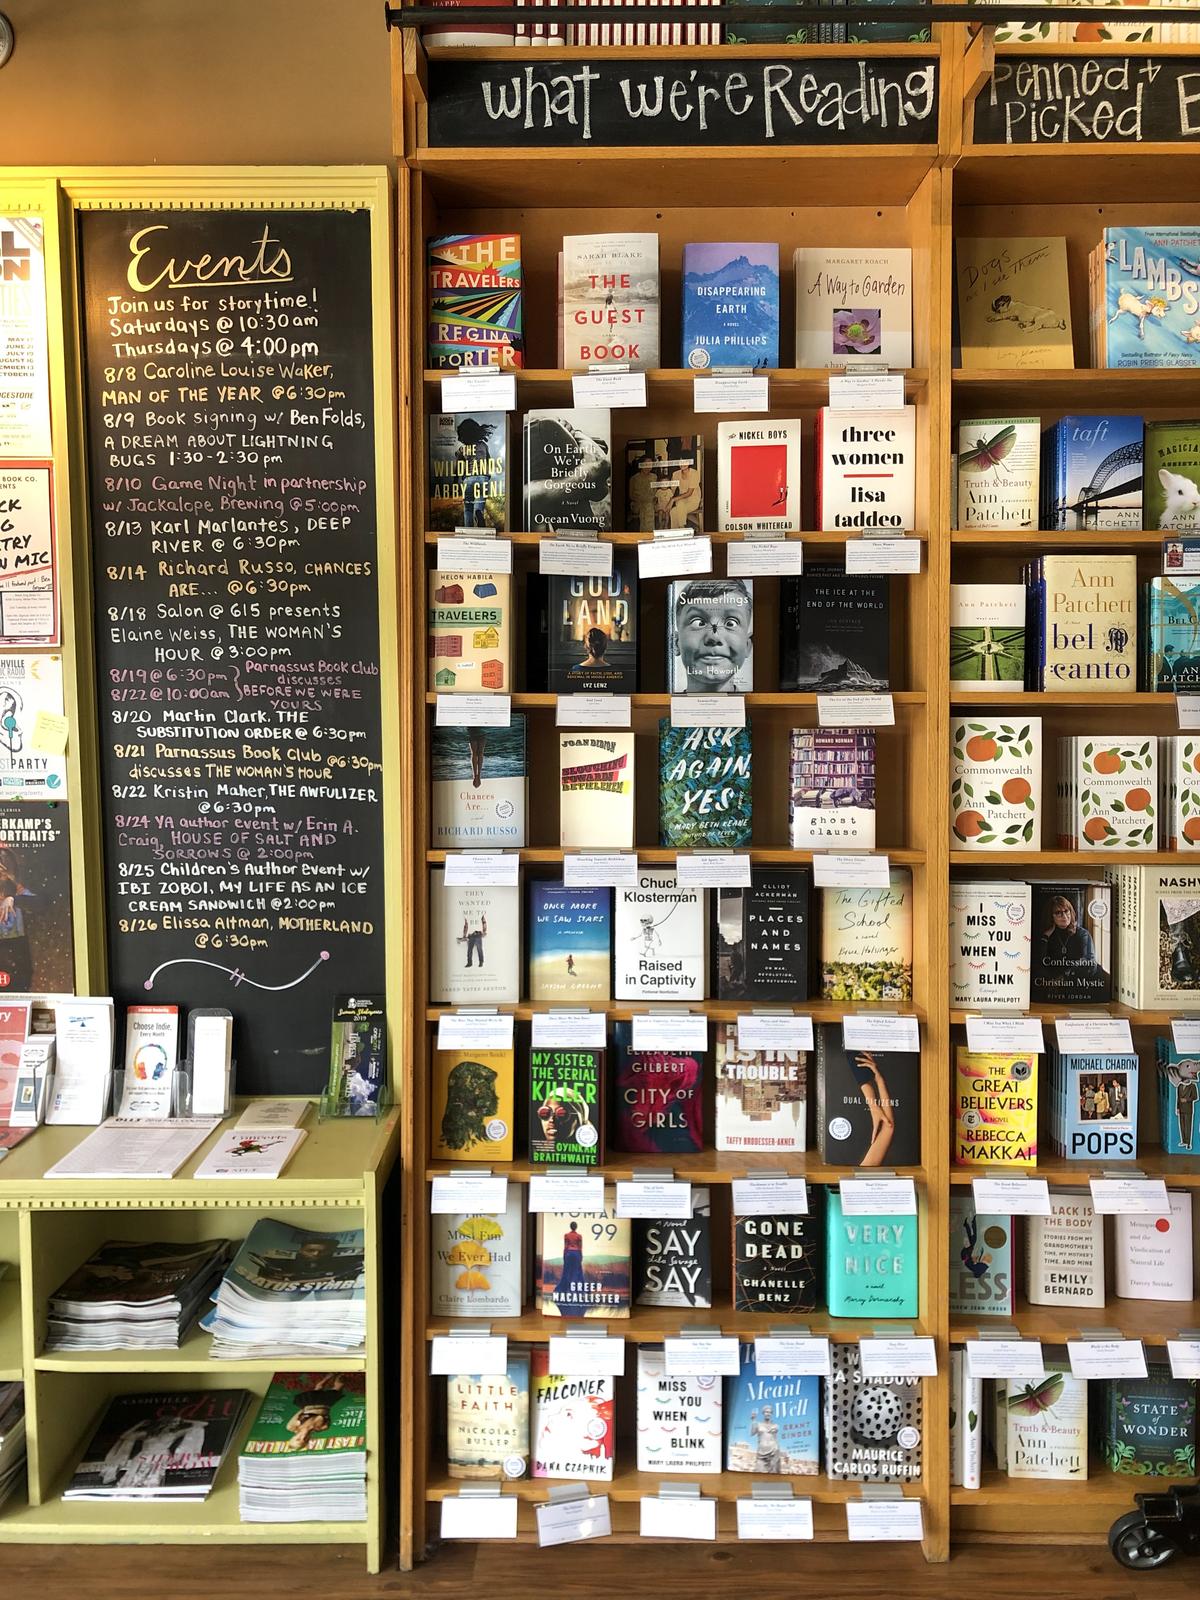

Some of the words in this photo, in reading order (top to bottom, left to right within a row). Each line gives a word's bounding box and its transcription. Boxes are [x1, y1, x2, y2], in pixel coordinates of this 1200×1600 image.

[764, 61, 935, 137] Reading
[459, 237, 516, 263] THE
[127, 223, 292, 292] Events
[431, 271, 520, 288] TRAVELERS
[588, 274, 631, 289] THE
[697, 286, 766, 296] DISAPPEARING
[808, 272, 822, 296] A
[826, 274, 847, 305] Way
[849, 279, 859, 294] to
[862, 275, 905, 296] Garden
[108, 296, 148, 314] Join
[155, 300, 174, 311] us
[184, 296, 208, 311] for
[219, 288, 318, 313] storytime!
[716, 305, 747, 314] EARTH
[574, 309, 645, 325] GUEST
[695, 336, 720, 345] JULIA
[724, 336, 767, 345] PHILLIPS
[439, 347, 516, 367] PORTER
[580, 344, 639, 360] BOOK
[104, 367, 136, 382] 8/8
[144, 362, 215, 380] Caroline
[221, 362, 274, 378] Louise
[102, 390, 141, 406] MAN
[149, 390, 169, 404] OF
[178, 388, 208, 402] THE
[218, 386, 263, 402] YEAR
[104, 412, 134, 428] 8/9
[146, 411, 186, 426] Book
[194, 408, 256, 430] signing
[264, 411, 282, 425] w/
[290, 409, 319, 425] Ben
[321, 408, 366, 429] Folds,
[105, 436, 114, 449] A
[122, 435, 178, 449] DREAM
[188, 434, 236, 447] ABOUT
[242, 434, 334, 449] LIGHTNING
[739, 431, 764, 440] NICKEL
[768, 430, 787, 439] BOYS
[842, 427, 896, 443] three
[1072, 420, 1109, 449] taft
[832, 452, 904, 466] women
[104, 476, 142, 492] 8/10
[152, 476, 203, 490] Game
[209, 476, 256, 496] Night
[264, 472, 276, 488] in
[281, 477, 366, 494] partnership
[544, 479, 596, 493] Gorgeous
[964, 480, 990, 488] Truth
[992, 480, 999, 488] &
[1002, 479, 1033, 489] Beauty
[851, 487, 886, 503] lisa
[534, 514, 569, 524] Ocean
[571, 514, 605, 525] Vuong
[757, 521, 792, 529] WHITEHEAD
[835, 511, 902, 528] taddeo
[15, 551, 49, 568] MIC
[106, 565, 147, 580] 8/14
[159, 560, 229, 576] Richard
[239, 560, 296, 575] Russo,
[305, 561, 372, 576] CHANCES
[1072, 568, 1114, 588] Ann
[679, 592, 749, 607] Summerlings
[1053, 592, 1133, 613] Patchett
[563, 600, 628, 626] LAND
[111, 628, 163, 643] Elaine
[169, 627, 222, 643] Weiss,
[228, 624, 257, 638] THE
[266, 623, 342, 639] WOMAN'S
[955, 765, 1033, 775] Commonwealth
[112, 785, 146, 798] 8/22
[154, 784, 208, 798] Kristin
[217, 784, 268, 799] Maher,
[269, 784, 296, 796] THE
[300, 786, 378, 802] AWFULIZER
[811, 816, 856, 825] ghost
[438, 827, 483, 835] RICHARD
[487, 827, 518, 835] RUSSO
[809, 827, 858, 836] clause
[624, 892, 696, 902] Klosterman
[119, 920, 157, 932] 8/26
[162, 916, 210, 930] Elissa
[215, 918, 273, 931] Altman,
[279, 917, 373, 934] MOTHERLAND
[749, 915, 803, 923] PLACES
[967, 916, 996, 926] MISS
[988, 931, 1011, 941] YOU
[961, 946, 996, 956] WHEN
[639, 960, 682, 971] Raised
[626, 974, 636, 984] in
[640, 974, 696, 988] Captivity
[979, 974, 1014, 984] BLINK
[1034, 978, 1074, 988] Christian
[1077, 978, 1104, 989] Mystic
[133, 1022, 154, 1030] Choose
[532, 1053, 550, 1066] MY
[1070, 1059, 1103, 1070] MICHAEL
[1106, 1060, 1137, 1071] CHABON
[532, 1067, 553, 1080] THE
[558, 1068, 597, 1081] SERIAL
[632, 1062, 685, 1073] GILBERT
[726, 1065, 798, 1081] TROUBLE
[532, 1081, 597, 1104] KILLER
[972, 1079, 1021, 1092] GREAT
[624, 1088, 671, 1105] CITY
[676, 1089, 694, 1099] OF
[961, 1097, 1033, 1110] BELIEVERS
[631, 1112, 688, 1128] GIRLS
[966, 1130, 1026, 1142] REBECCA
[1072, 1132, 1133, 1154] POPS
[534, 1152, 596, 1164] BRAITHWAITE
[961, 1145, 1032, 1161] MAKKAI
[745, 1221, 804, 1235] GONE
[646, 1229, 701, 1255] SAY
[745, 1244, 803, 1259] DEAD
[743, 1279, 805, 1288] CHANELLE
[1050, 1274, 1087, 1284] EMILY
[553, 1293, 620, 1303] MACALLISTER
[758, 1294, 791, 1302] BENZ
[1044, 1286, 1093, 1296] BERNARD
[458, 1384, 518, 1396] LITTLE
[537, 1379, 605, 1404] FALCONER
[461, 1401, 513, 1411] FAITH
[1133, 1404, 1178, 1415] STATE
[1123, 1424, 1189, 1437] WONDER
[852, 1449, 903, 1462] MAURICE
[834, 1462, 876, 1474] CARLOS
[882, 1463, 920, 1476] RUFFIN
